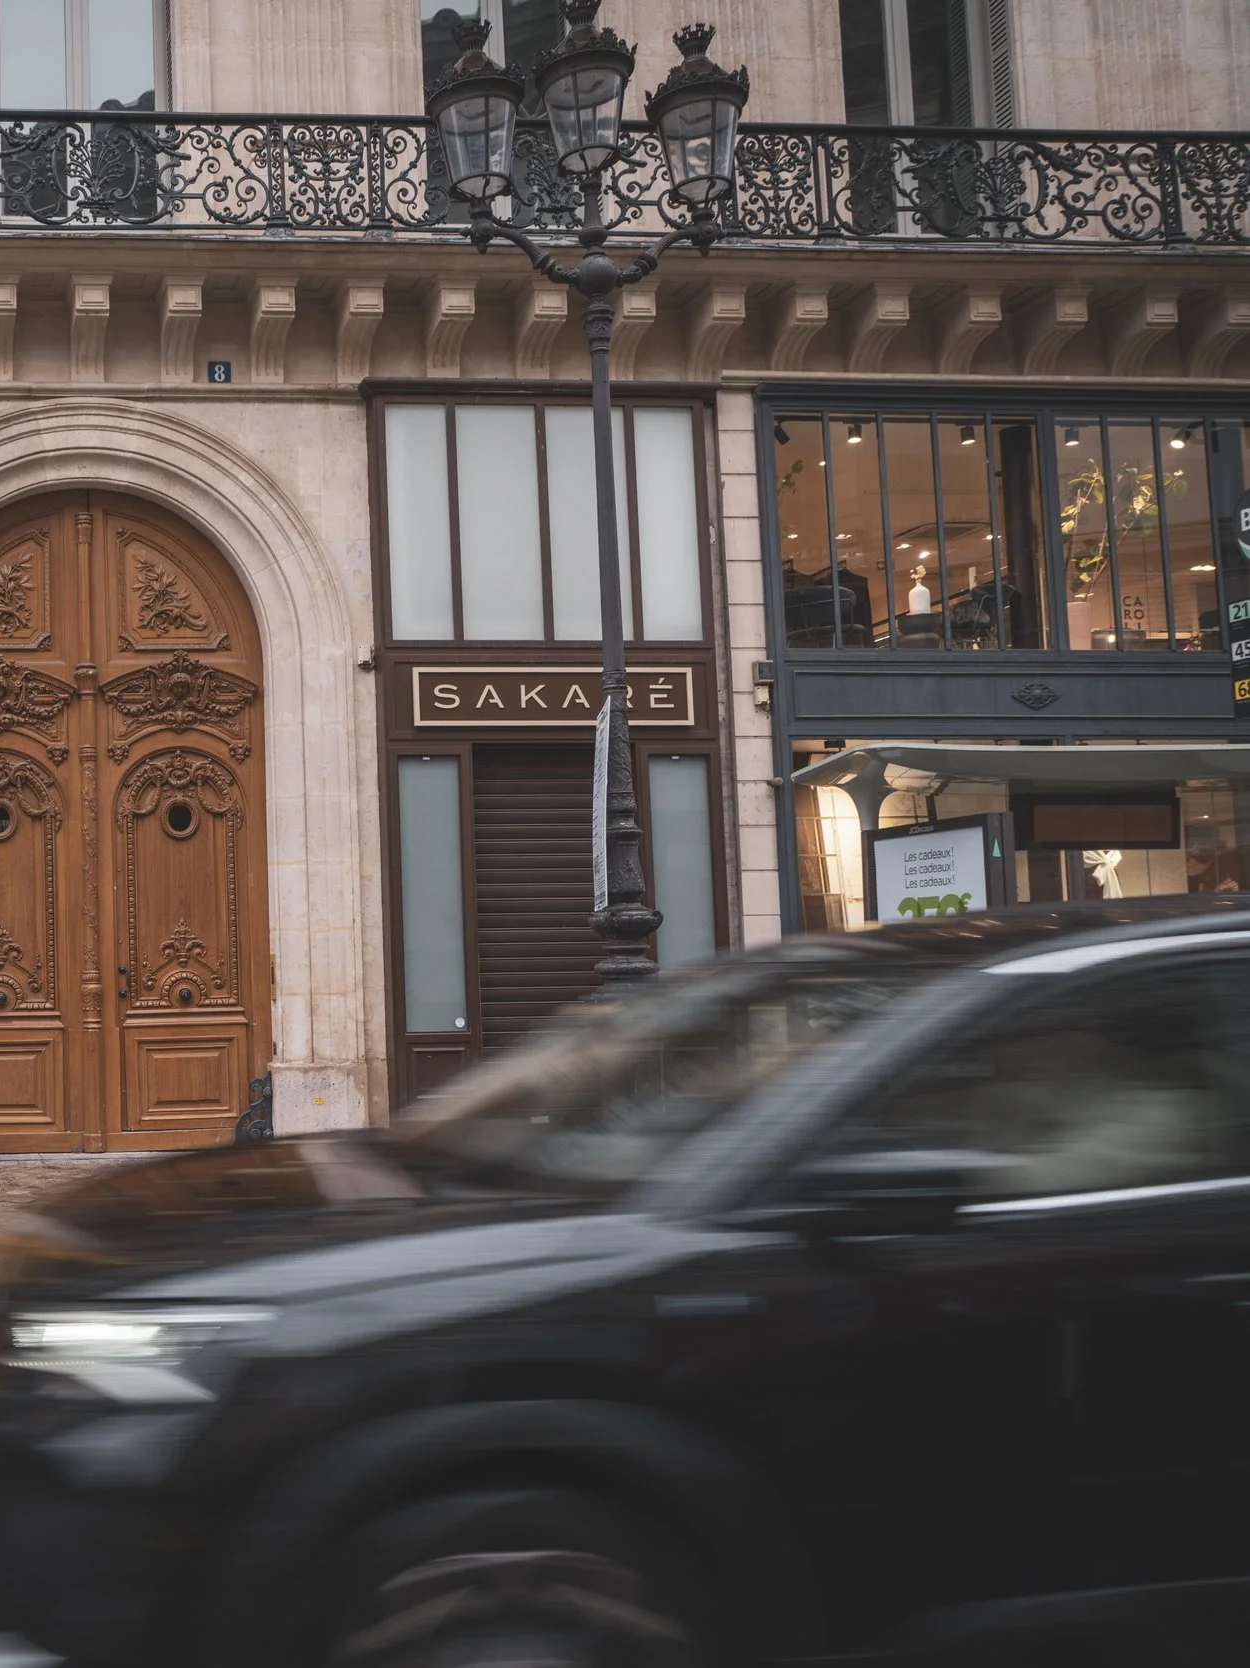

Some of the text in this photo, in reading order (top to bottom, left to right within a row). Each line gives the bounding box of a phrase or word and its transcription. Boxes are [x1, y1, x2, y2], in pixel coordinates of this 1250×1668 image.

[214, 364, 225, 382] 8
[1123, 596, 1143, 607] CA
[1124, 609, 1144, 620] RO
[1233, 602, 1249, 620] 21
[904, 852, 917, 862] Les
[904, 865, 917, 876] Les
[905, 879, 918, 889] Les
